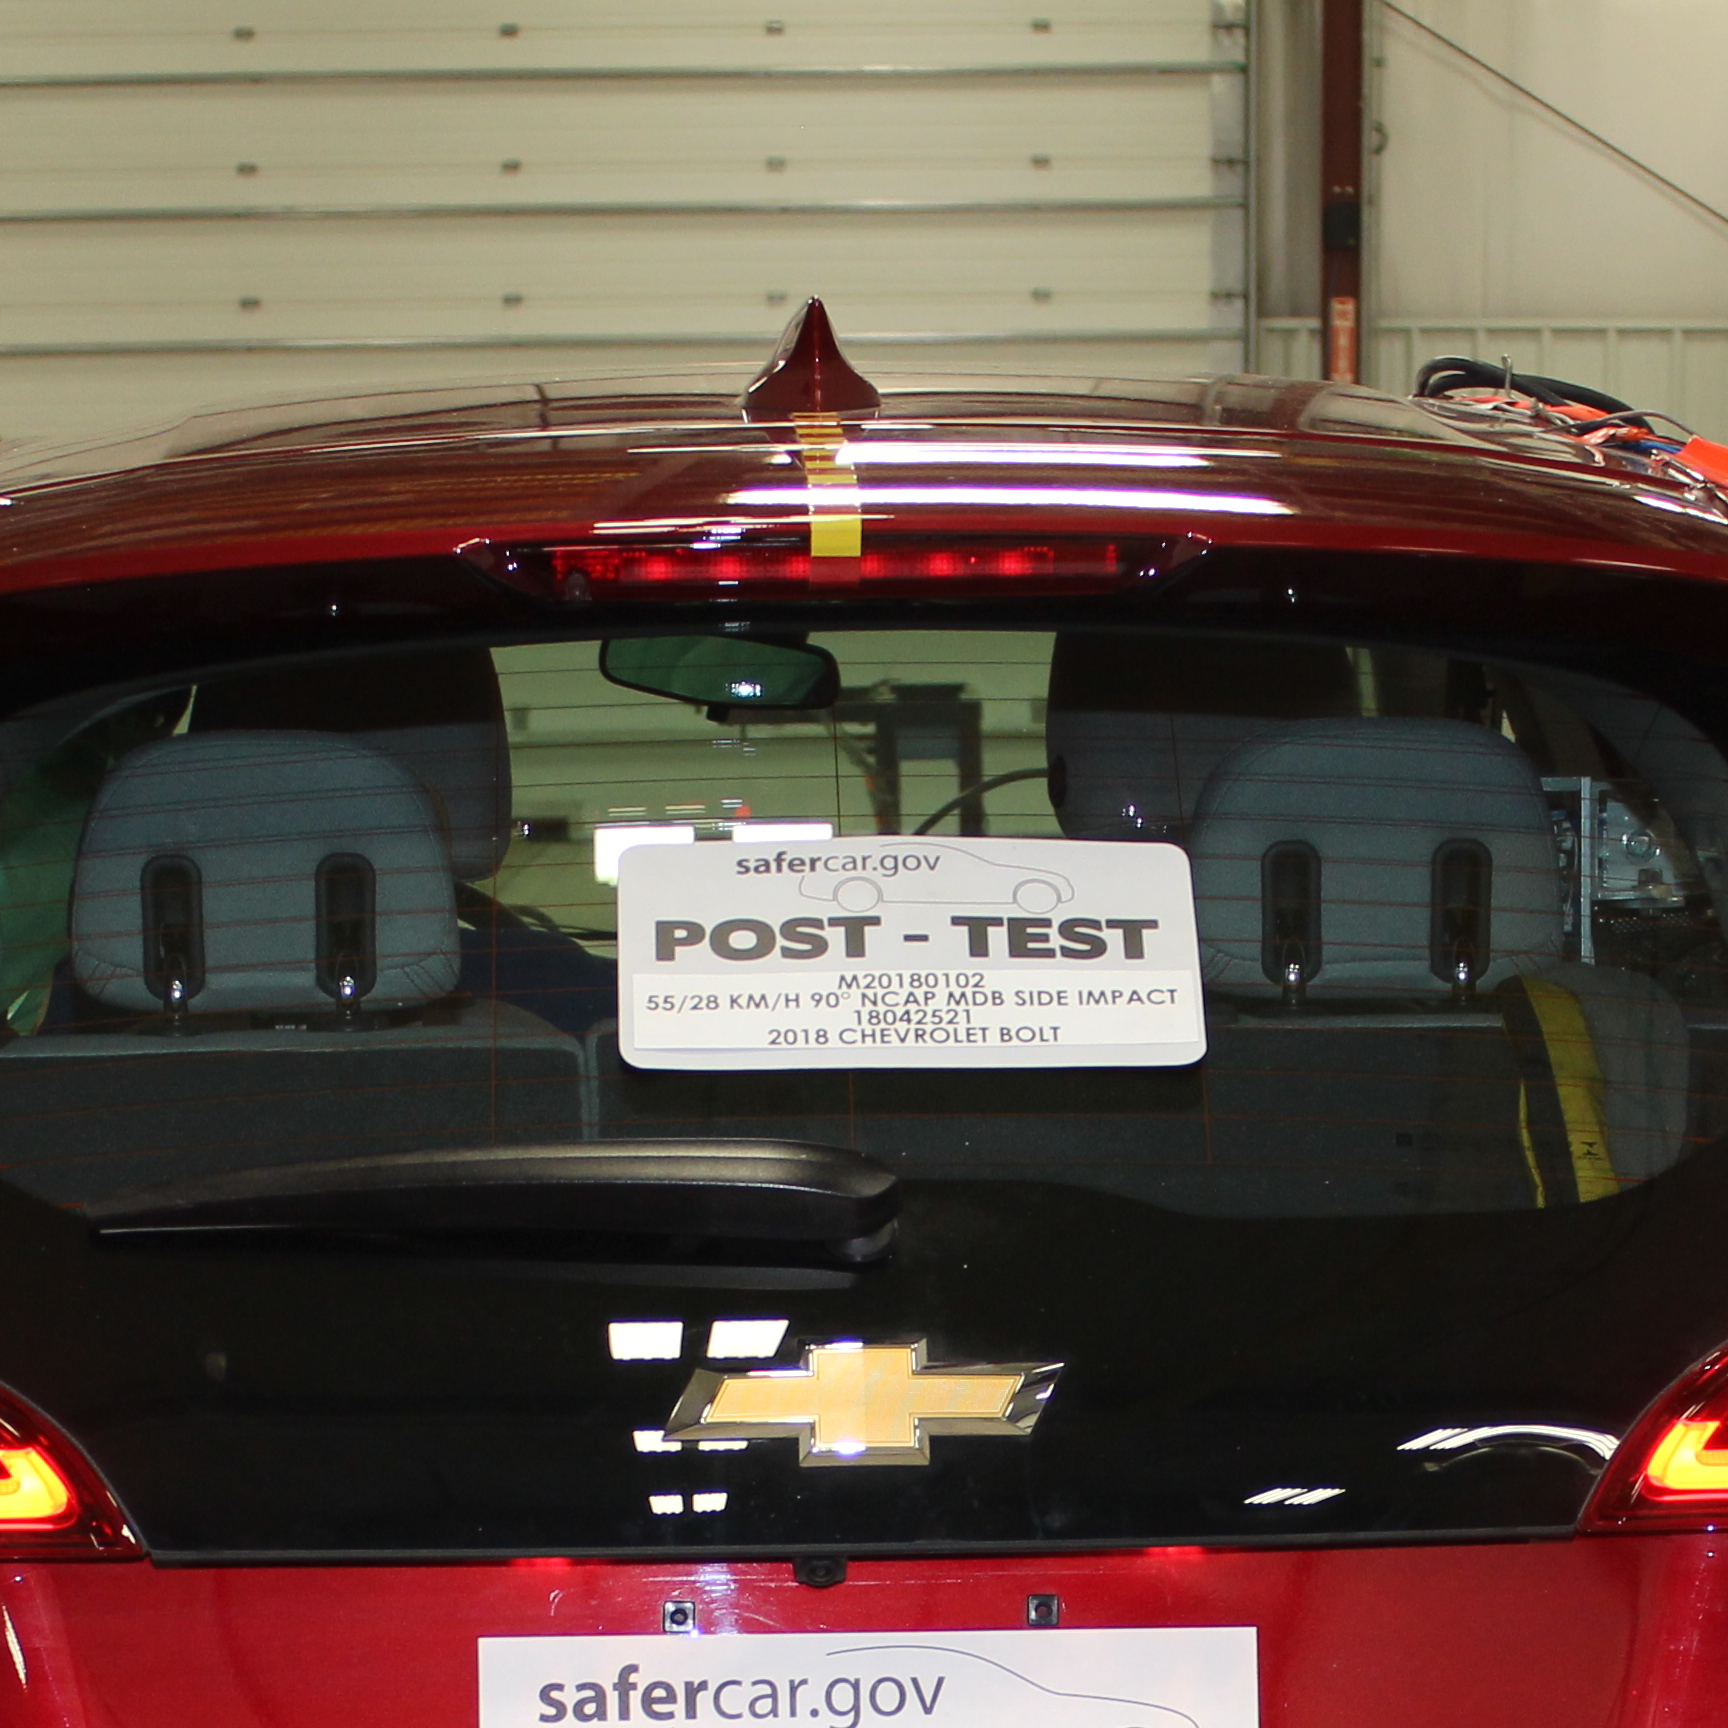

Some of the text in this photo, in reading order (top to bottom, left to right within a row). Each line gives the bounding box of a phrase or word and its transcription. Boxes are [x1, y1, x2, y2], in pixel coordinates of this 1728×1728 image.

[735, 850, 941, 878] safercar.gov
[654, 914, 882, 963] POST
[950, 914, 1160, 961] TEST
[837, 972, 986, 991] M20180102
[645, 994, 720, 1012] 55/28
[729, 992, 801, 1012] KM/H
[860, 991, 937, 1008] NCAP
[946, 990, 1005, 1007] MDB
[1014, 989, 1069, 1006] SIDE
[1078, 988, 1178, 1006] IMPACT
[853, 1009, 974, 1027] 18042521
[767, 1026, 1061, 1046] 2018 CHEVROLET BOLT
